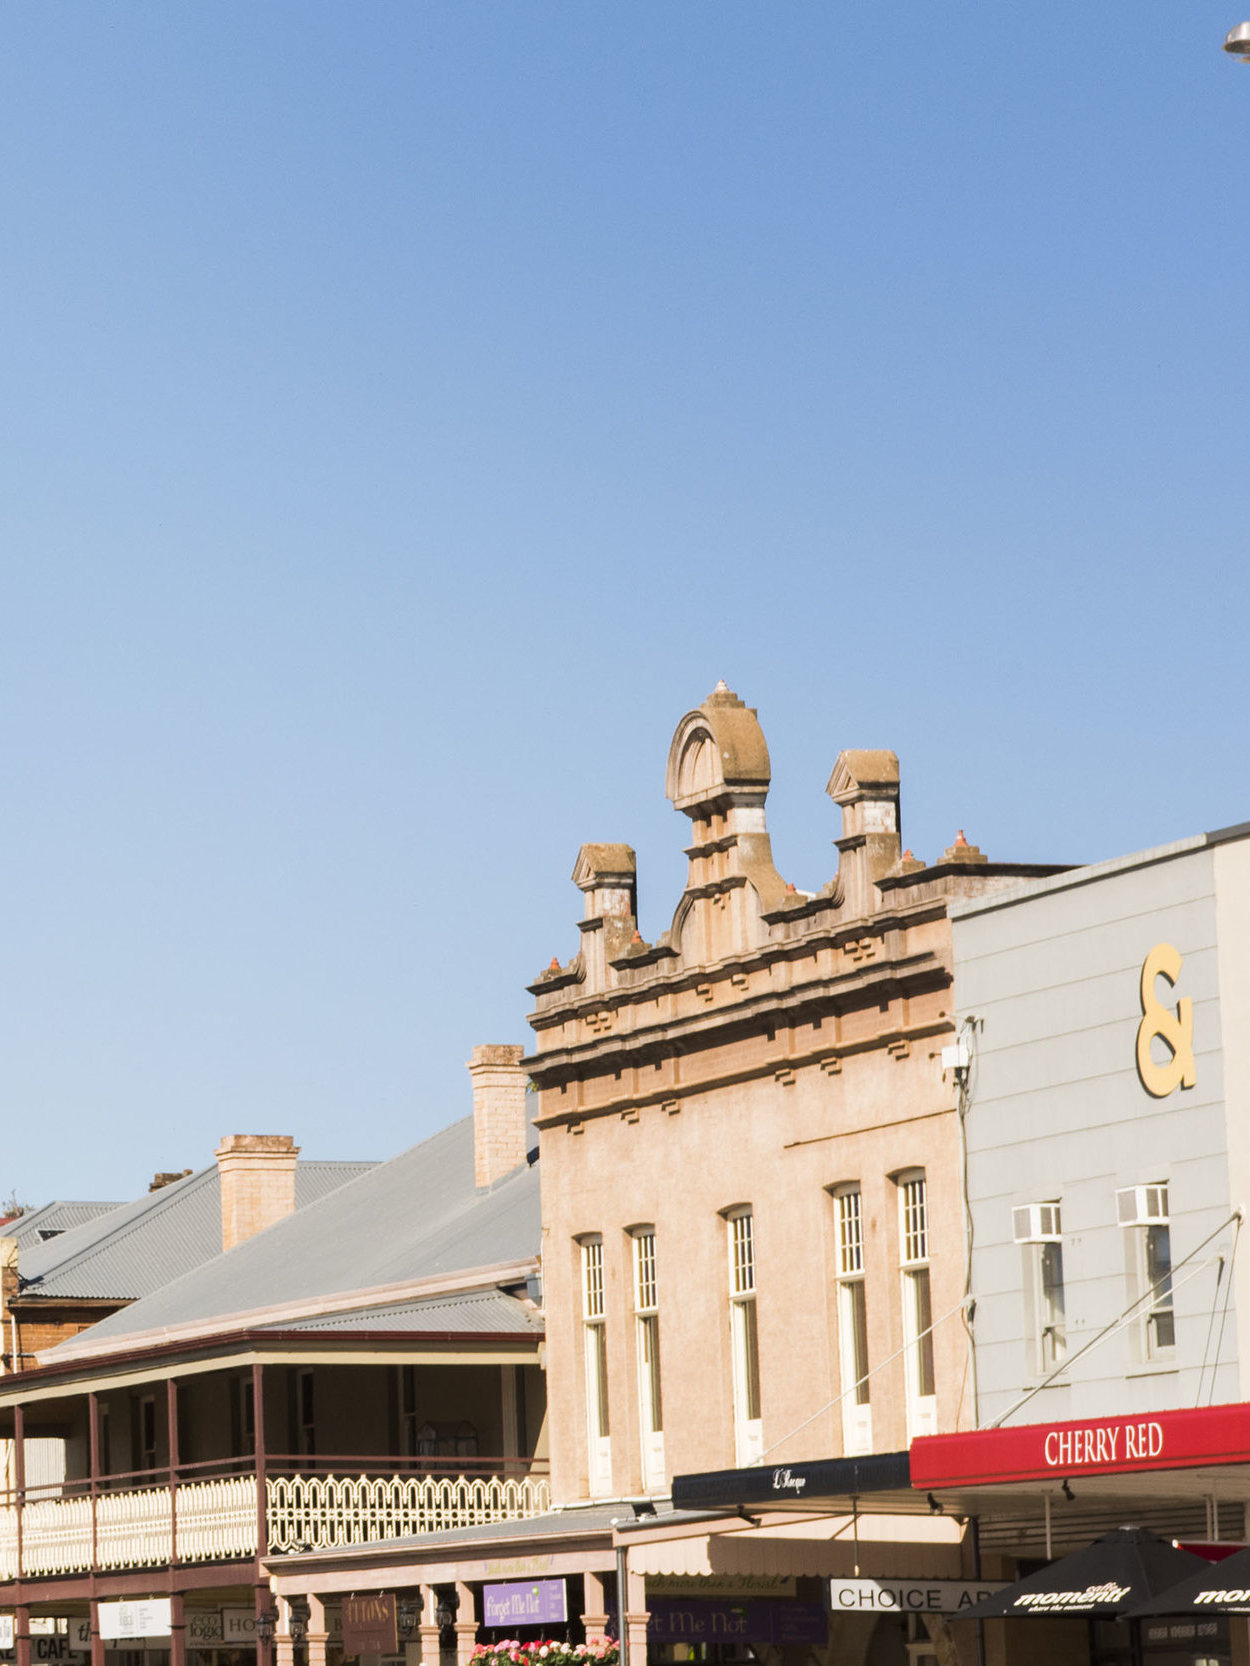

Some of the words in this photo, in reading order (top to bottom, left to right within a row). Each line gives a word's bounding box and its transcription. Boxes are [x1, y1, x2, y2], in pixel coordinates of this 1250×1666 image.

[1135, 943, 1197, 1099] &
[1044, 1427, 1120, 1466] CHERRY
[1125, 1422, 1164, 1460] RED
[838, 1588, 943, 1609] CHOICE
